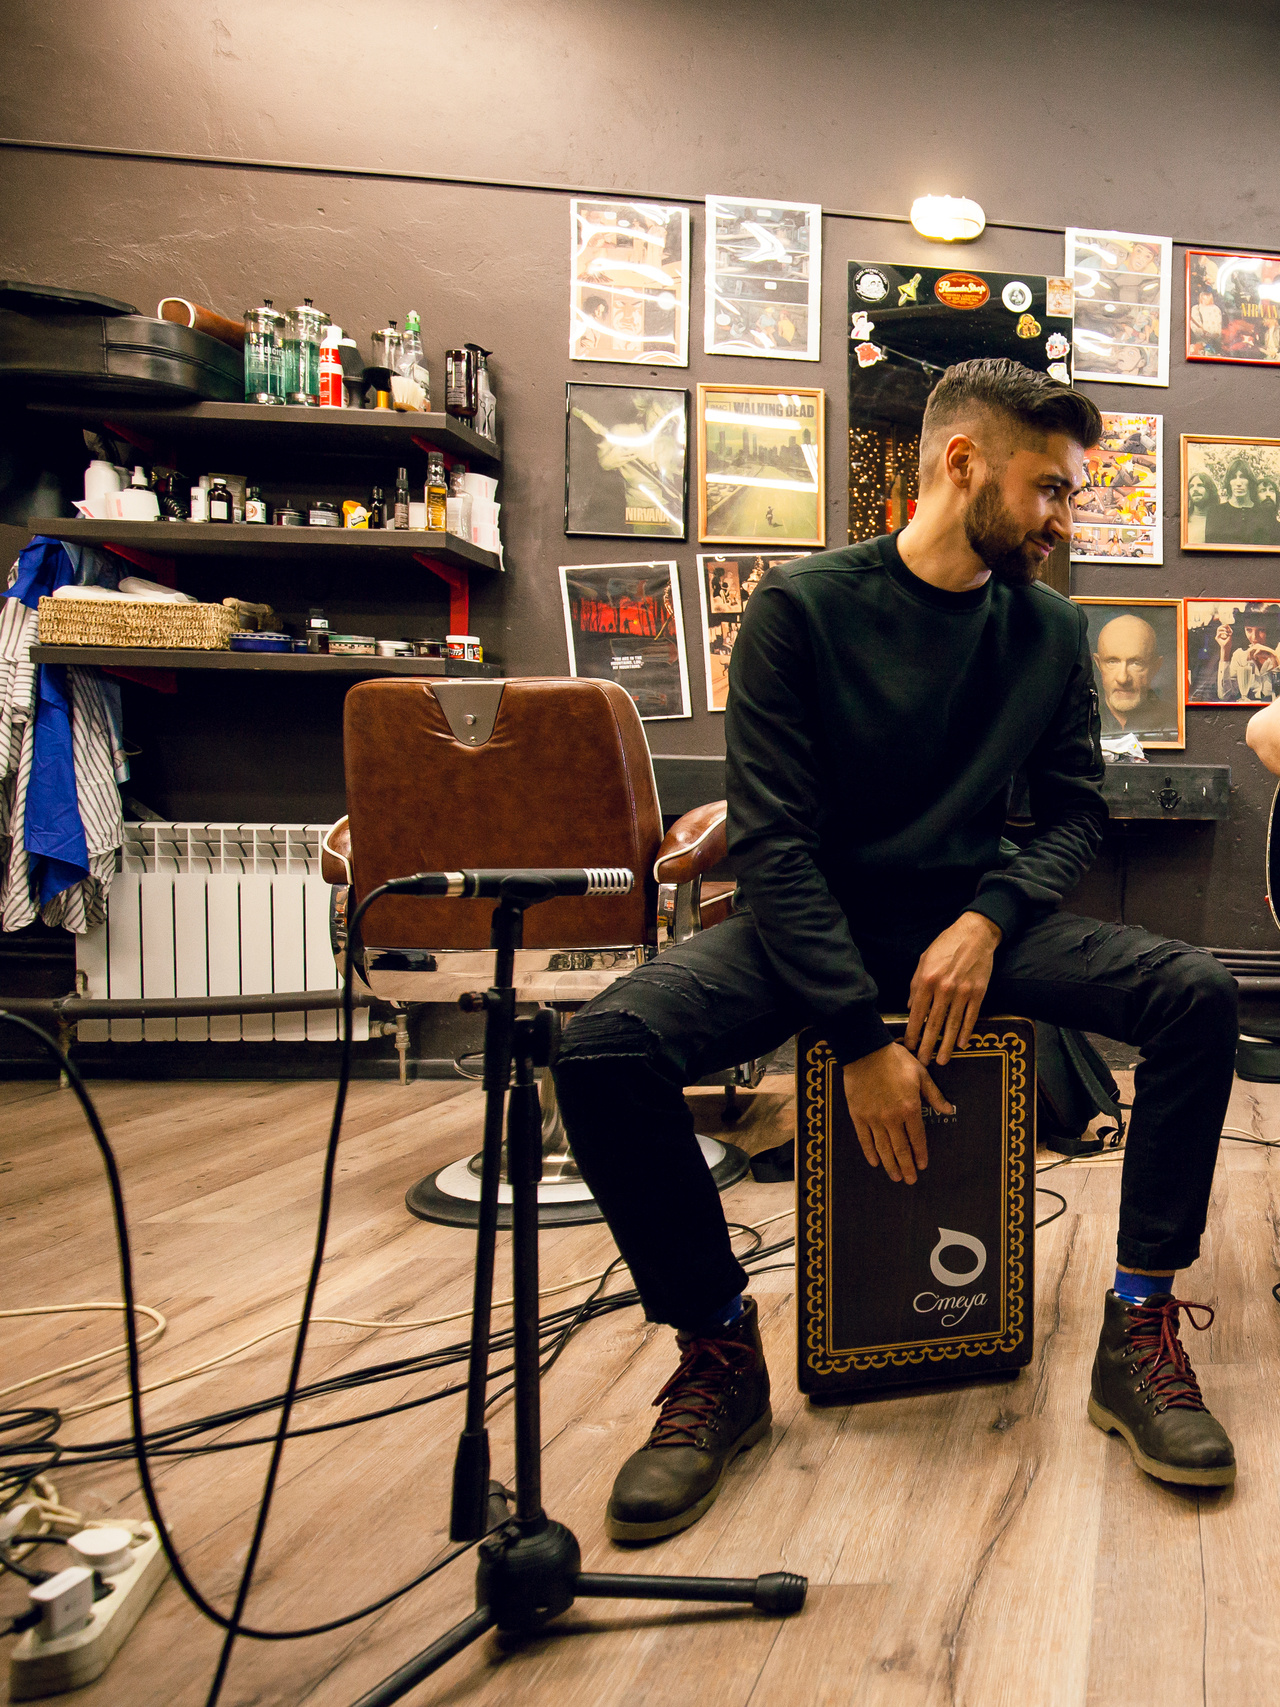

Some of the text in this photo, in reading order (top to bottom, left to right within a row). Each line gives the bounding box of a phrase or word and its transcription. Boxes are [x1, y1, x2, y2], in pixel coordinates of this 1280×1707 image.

[733, 402, 784, 418] WALKING
[785, 403, 815, 418] DEAD
[625, 507, 670, 522] NIRVANA
